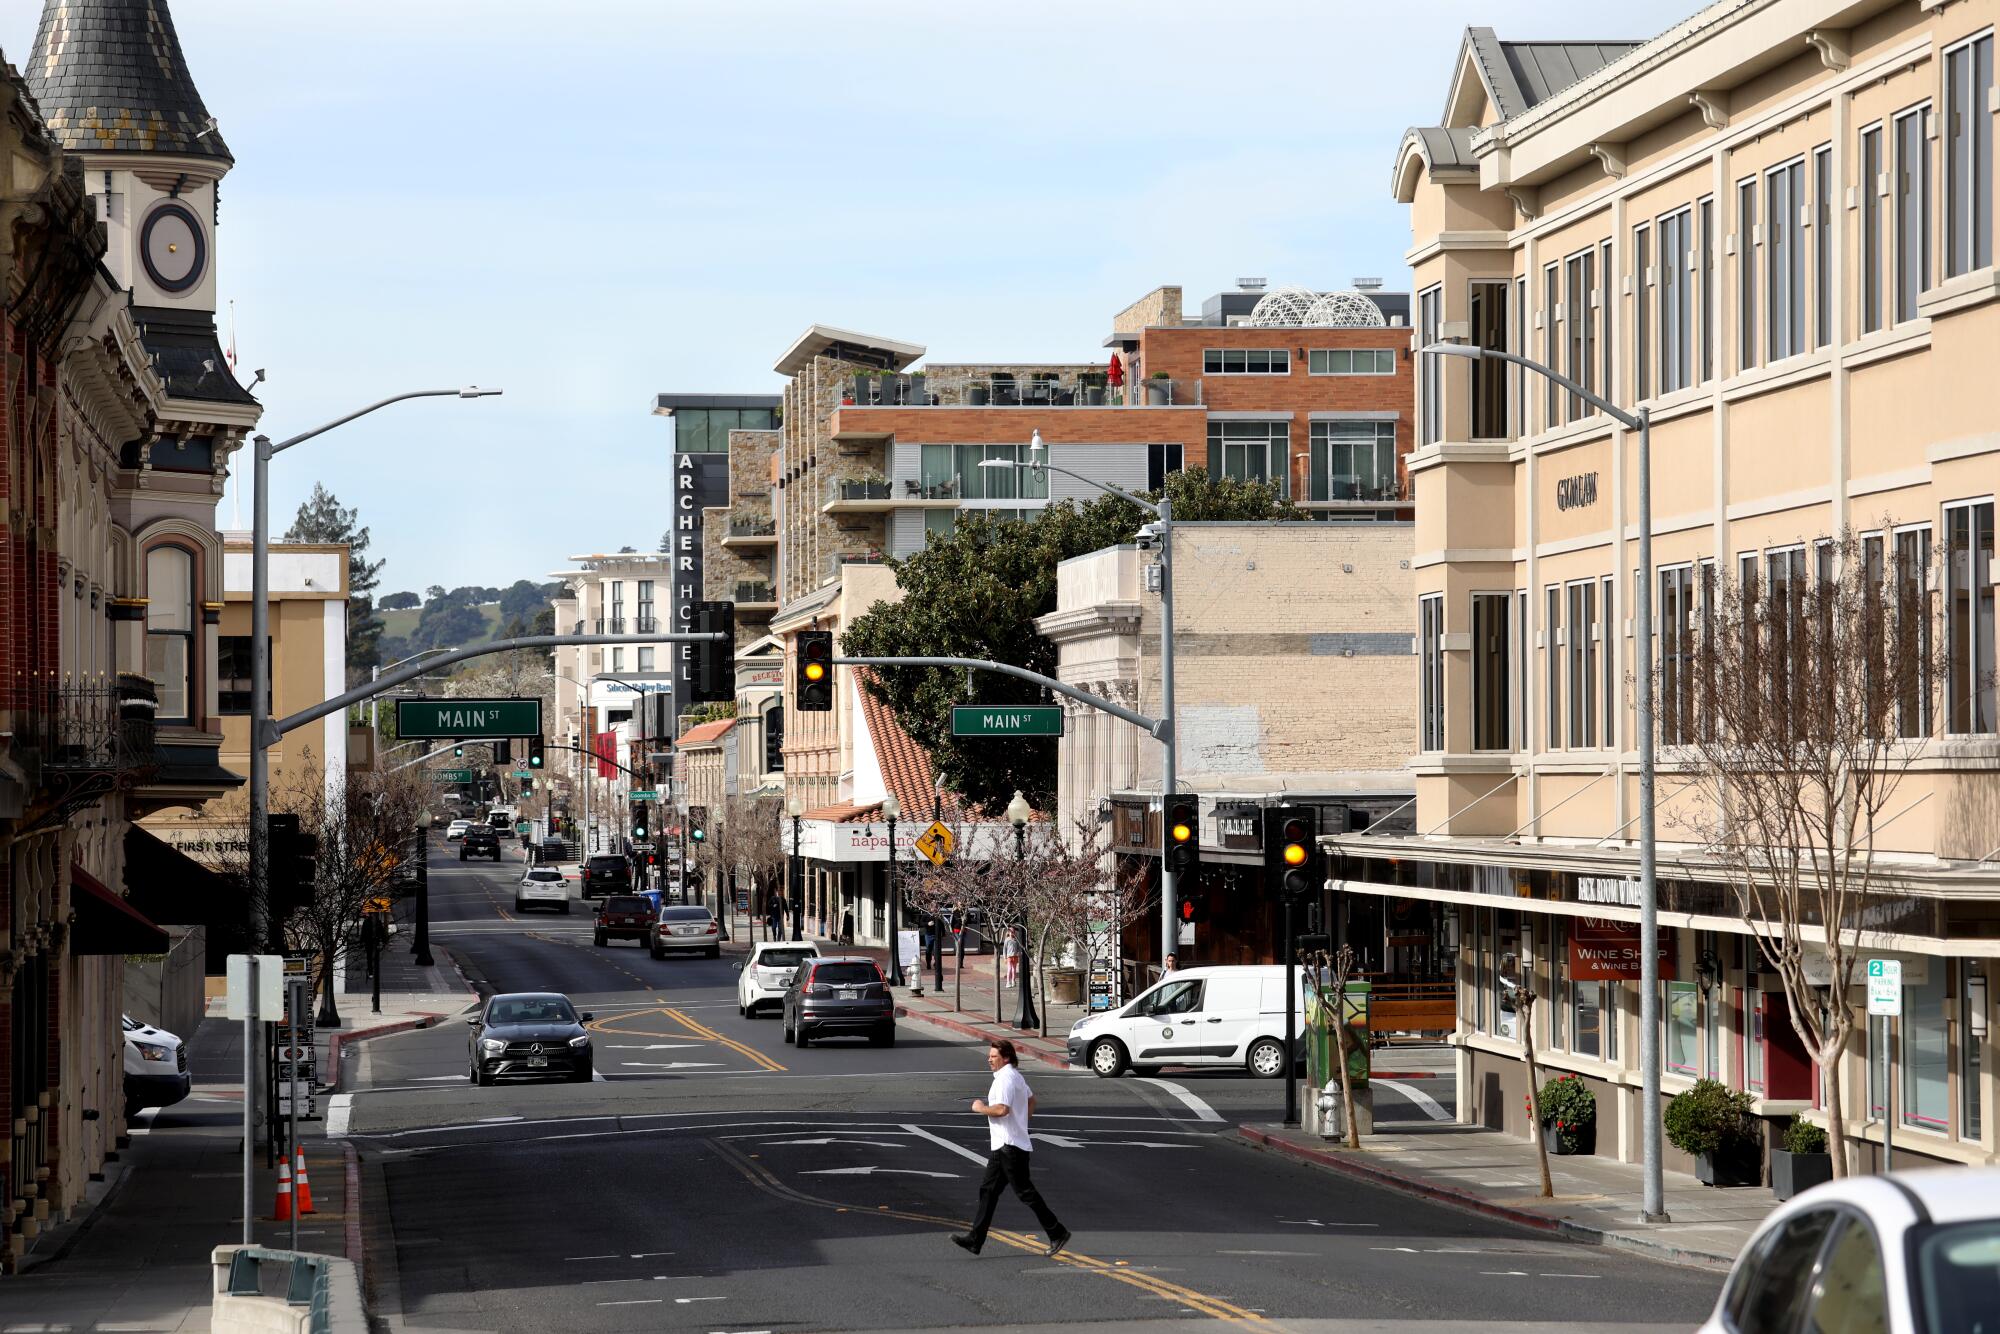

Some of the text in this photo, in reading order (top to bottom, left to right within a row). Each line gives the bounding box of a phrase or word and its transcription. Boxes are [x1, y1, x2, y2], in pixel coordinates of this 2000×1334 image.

[678, 454, 694, 681] ARCHER HOTEL
[632, 682, 655, 693] Valley
[656, 682, 672, 692] Ban
[438, 710, 500, 728] MAIN ST
[983, 714, 1032, 729] MAIN ST
[177, 841, 212, 852] FIRST
[215, 841, 249, 852] STRE
[851, 837, 888, 850] napa
[1622, 948, 1668, 959] SHP
[1591, 962, 1599, 970] &
[1872, 962, 1881, 975] 2
